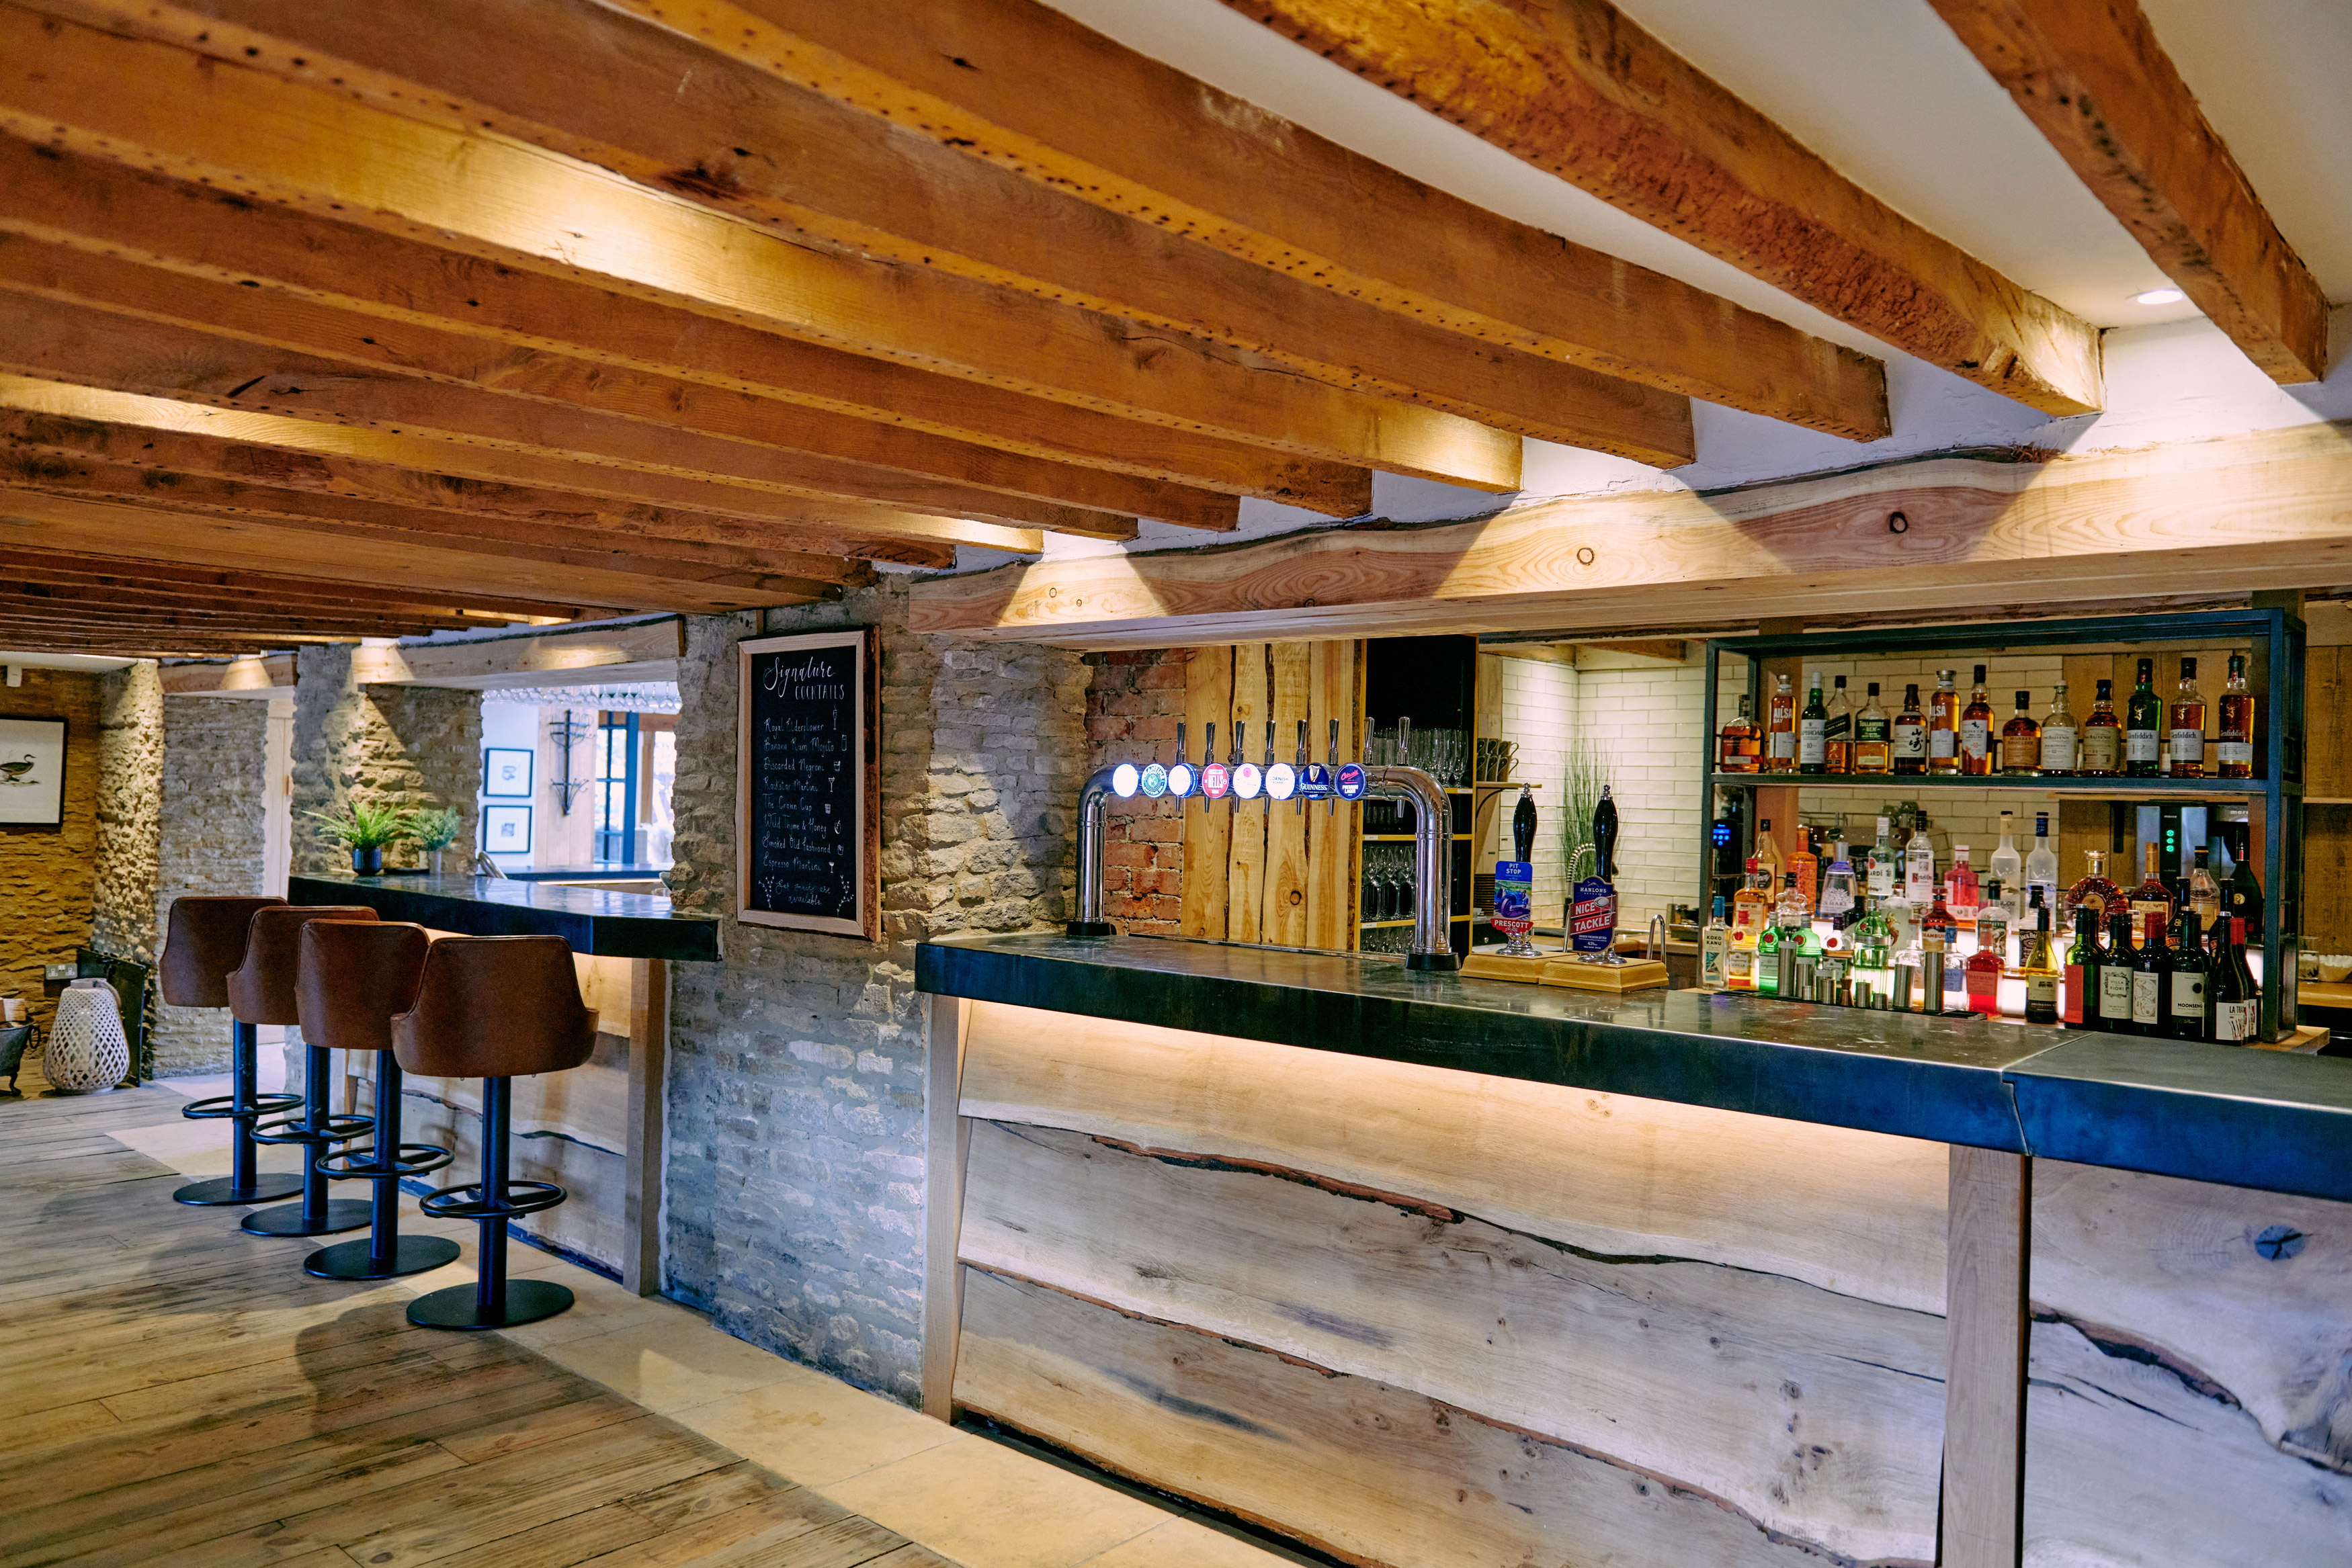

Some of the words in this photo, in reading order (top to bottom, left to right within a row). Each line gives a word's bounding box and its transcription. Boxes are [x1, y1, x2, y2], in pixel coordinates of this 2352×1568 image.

[763, 656, 836, 697] Signature
[795, 685, 845, 699] COCKTAILS
[1774, 708, 1792, 719] AILSA
[764, 717, 784, 739] Royal
[786, 717, 824, 739] Elderflower
[763, 737, 787, 752] Banana
[791, 737, 807, 751] Rum
[810, 737, 834, 757] Mojito
[763, 757, 795, 771] Discarded
[798, 758, 825, 778] Negroni
[763, 776, 790, 791] Rockstar
[793, 779, 818, 791] Martini
[1208, 775, 1223, 789] HELLS
[1300, 783, 1328, 791] GUINNESS
[763, 793, 774, 808] The
[779, 795, 797, 810] Crown
[800, 797, 812, 815] Cup
[763, 813, 780, 828] Wild
[782, 814, 800, 834] Thyme
[802, 820, 806, 830] &
[808, 818, 827, 838] Honey
[761, 831, 786, 847] Smoked
[789, 835, 800, 849] Old
[763, 851, 789, 871] Espresso
[792, 857, 821, 871] Martini
[788, 894, 822, 906] available
[1575, 902, 1595, 915] NICE
[1495, 920, 1529, 928] PRESCOTT
[1574, 916, 1610, 932] TACKLE
